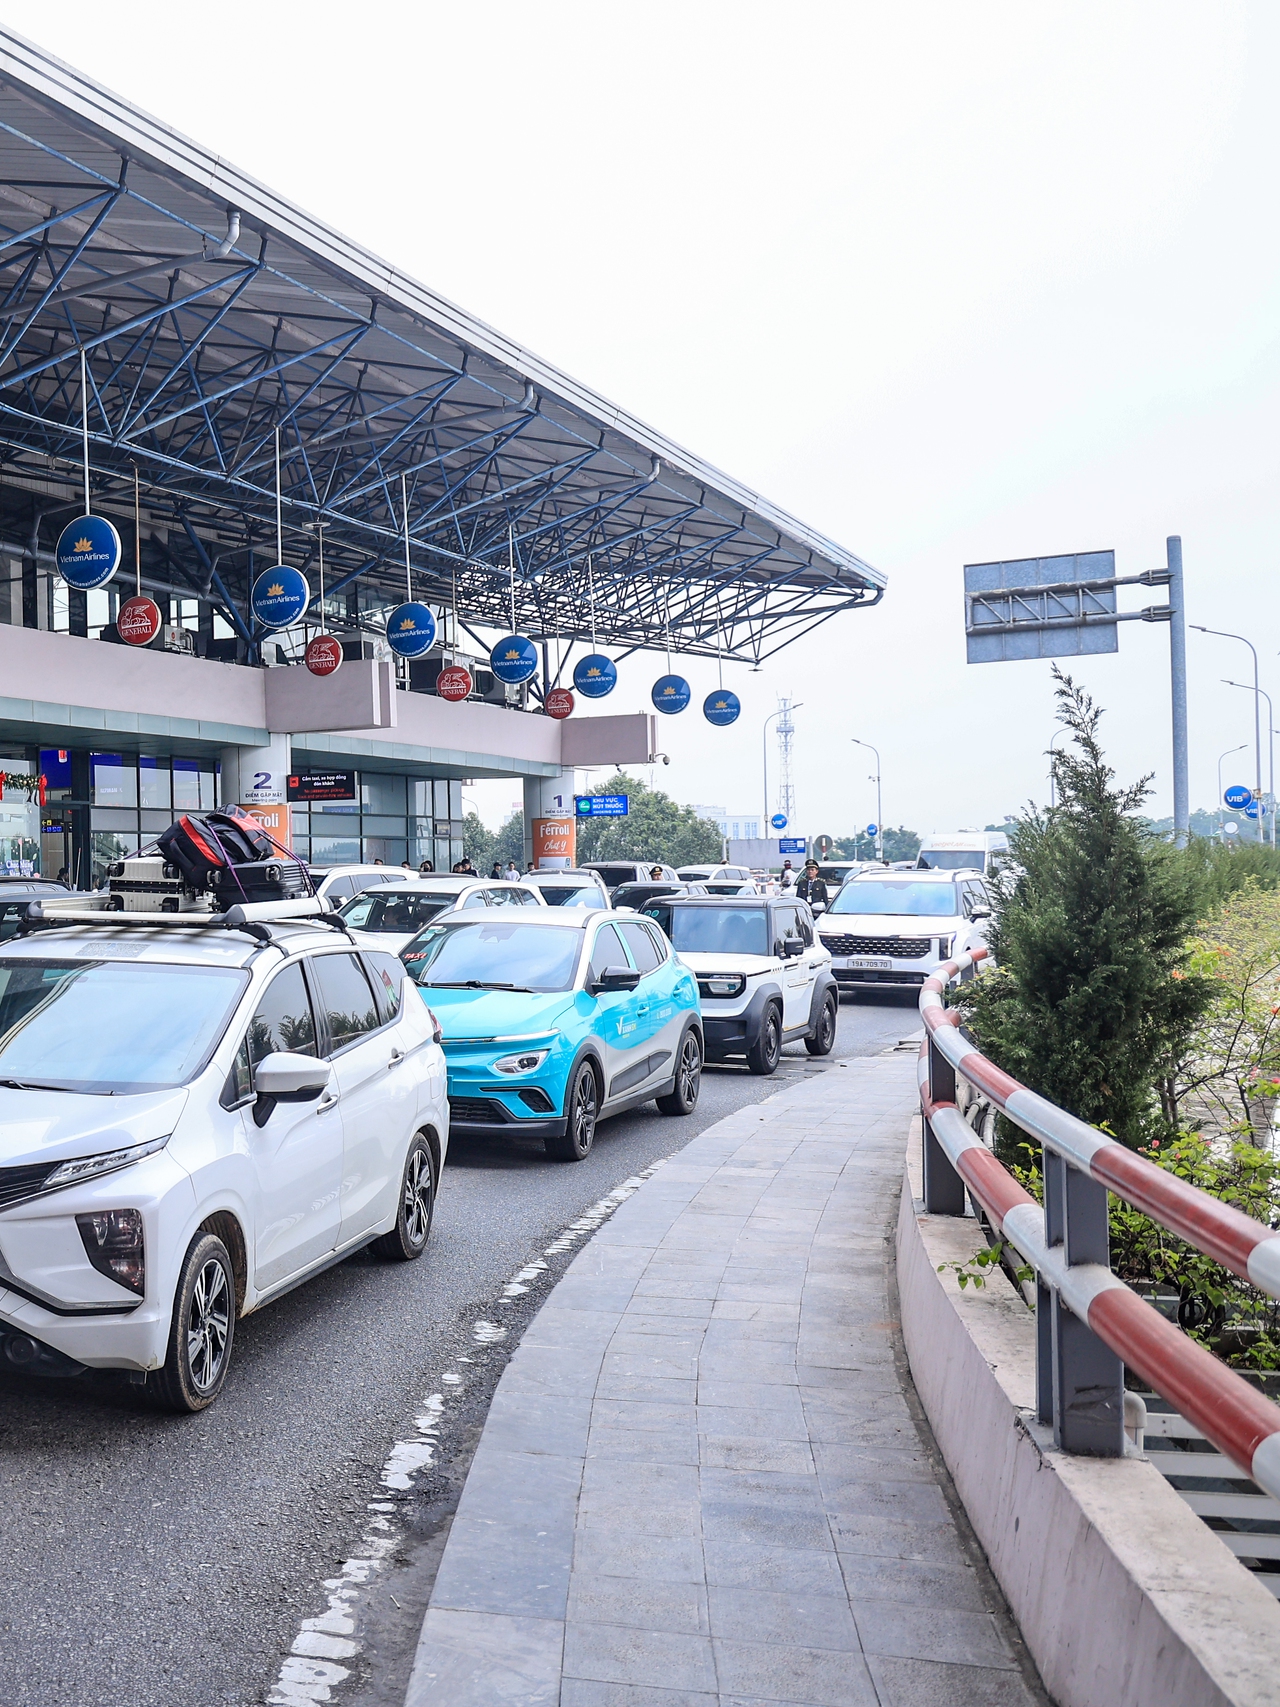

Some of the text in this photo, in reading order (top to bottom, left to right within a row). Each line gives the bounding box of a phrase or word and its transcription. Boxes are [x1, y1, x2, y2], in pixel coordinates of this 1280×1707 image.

[60, 555, 84, 563] Vietnam
[256, 598, 276, 606] Vietnam
[122, 626, 152, 636] GENERALI
[309, 661, 335, 669] GENERALI
[253, 772, 272, 789] 2
[554, 795, 562, 807] 1
